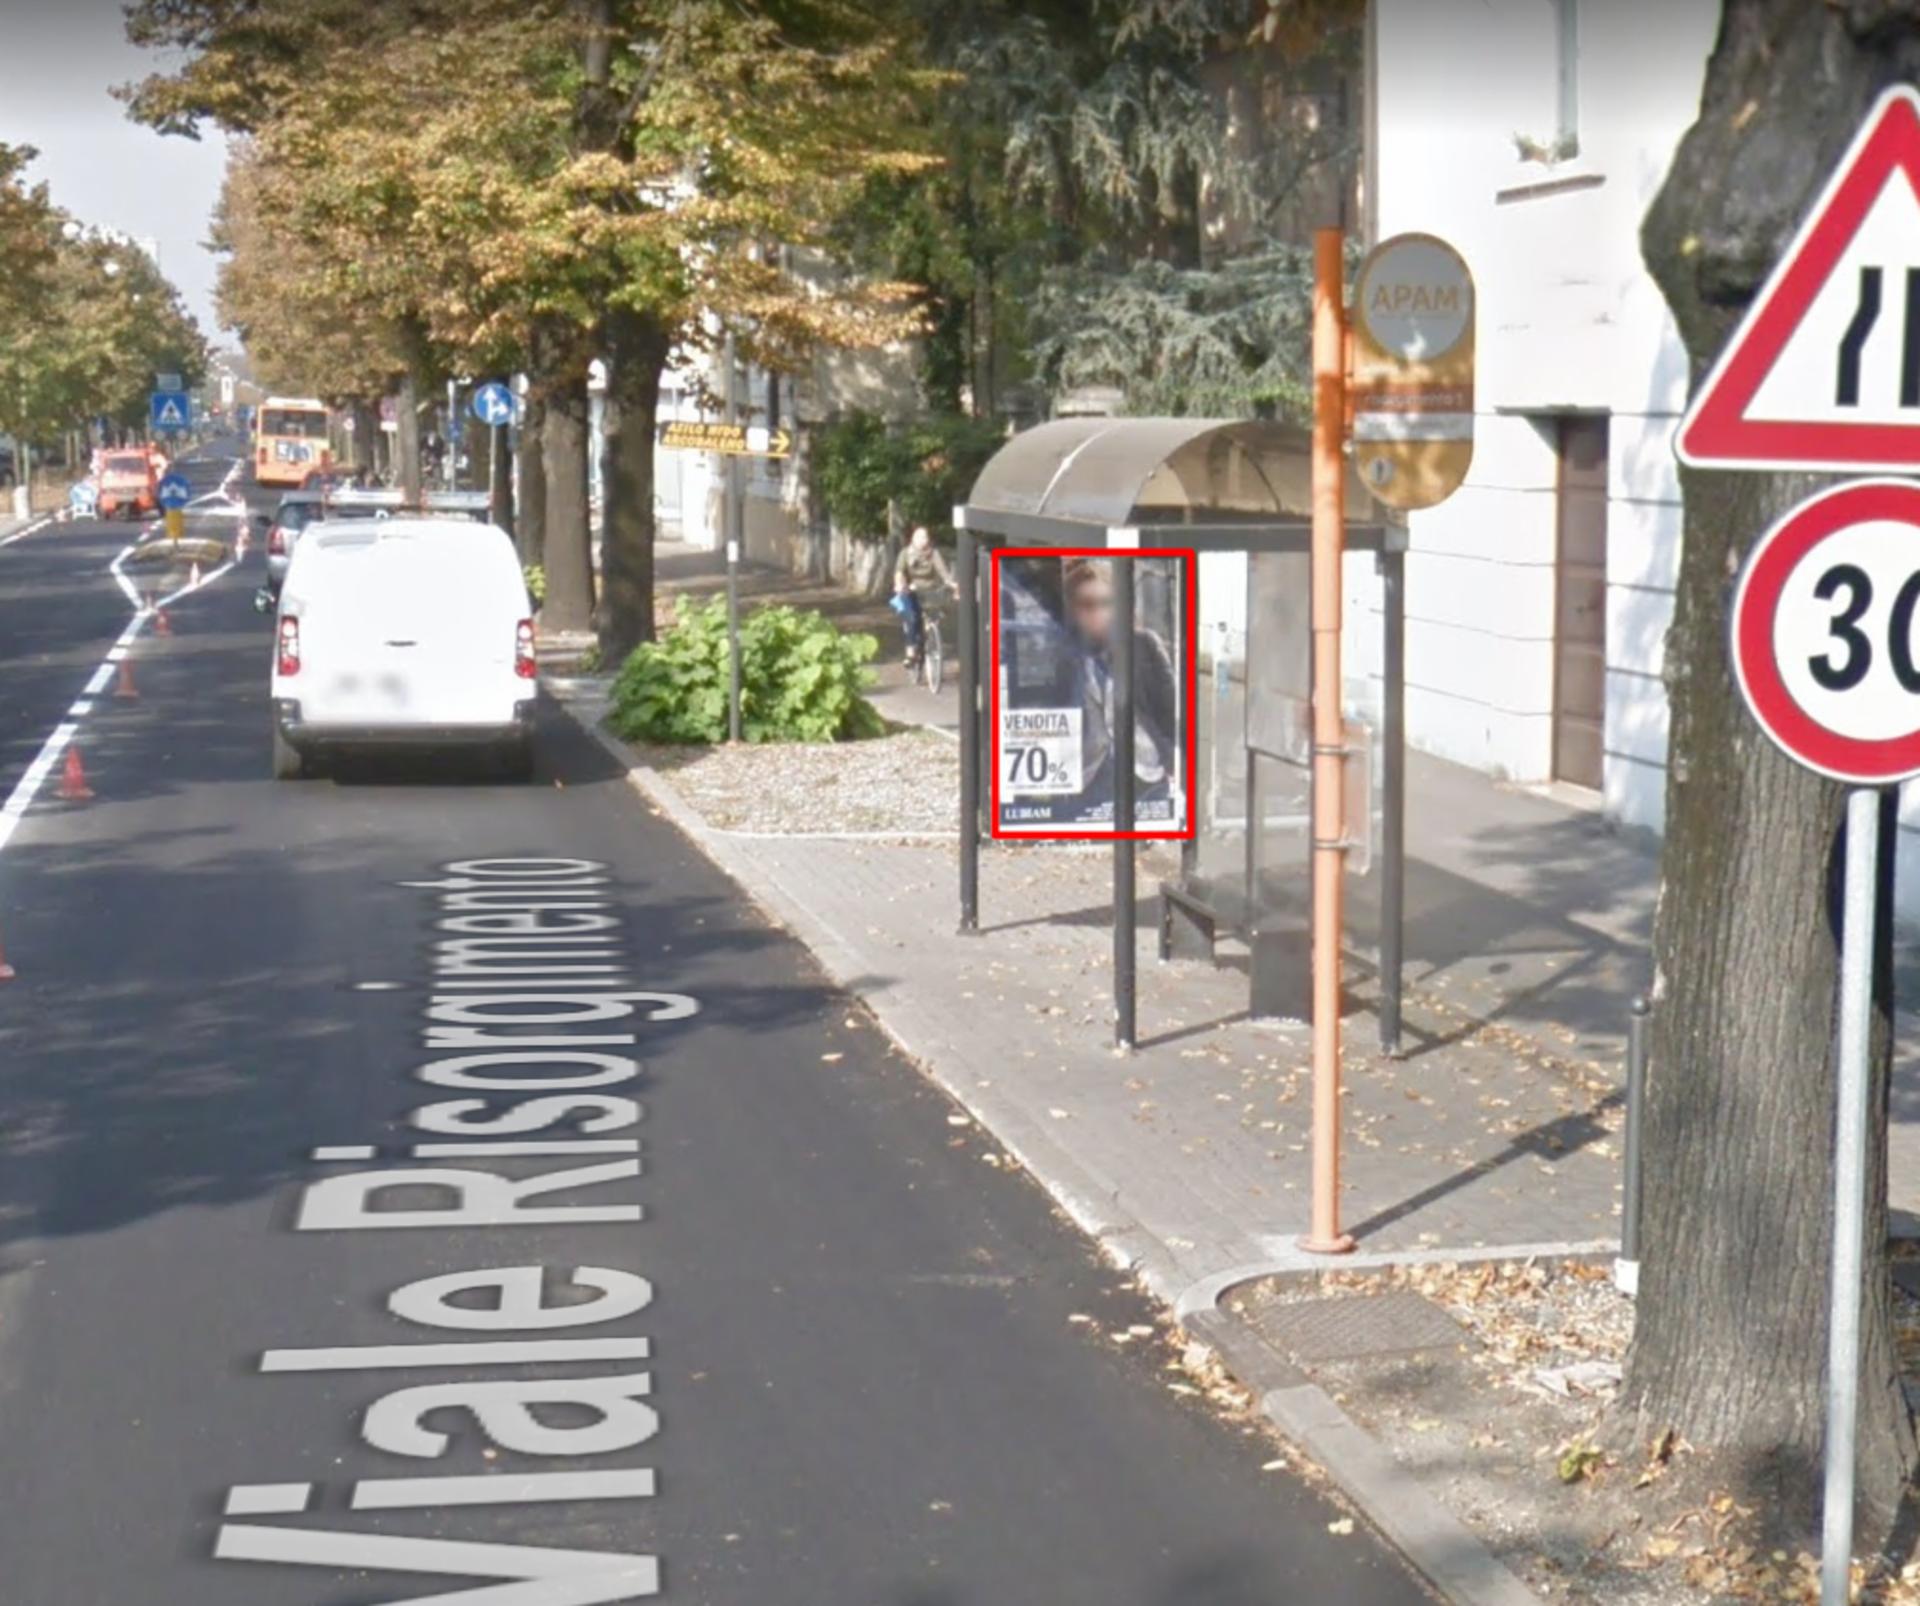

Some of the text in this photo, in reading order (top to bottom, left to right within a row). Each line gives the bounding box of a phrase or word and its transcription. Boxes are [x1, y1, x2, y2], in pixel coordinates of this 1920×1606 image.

[1371, 284, 1460, 311] APAM
[1004, 712, 1070, 730] VENDITA
[1004, 746, 1068, 783] 70%
